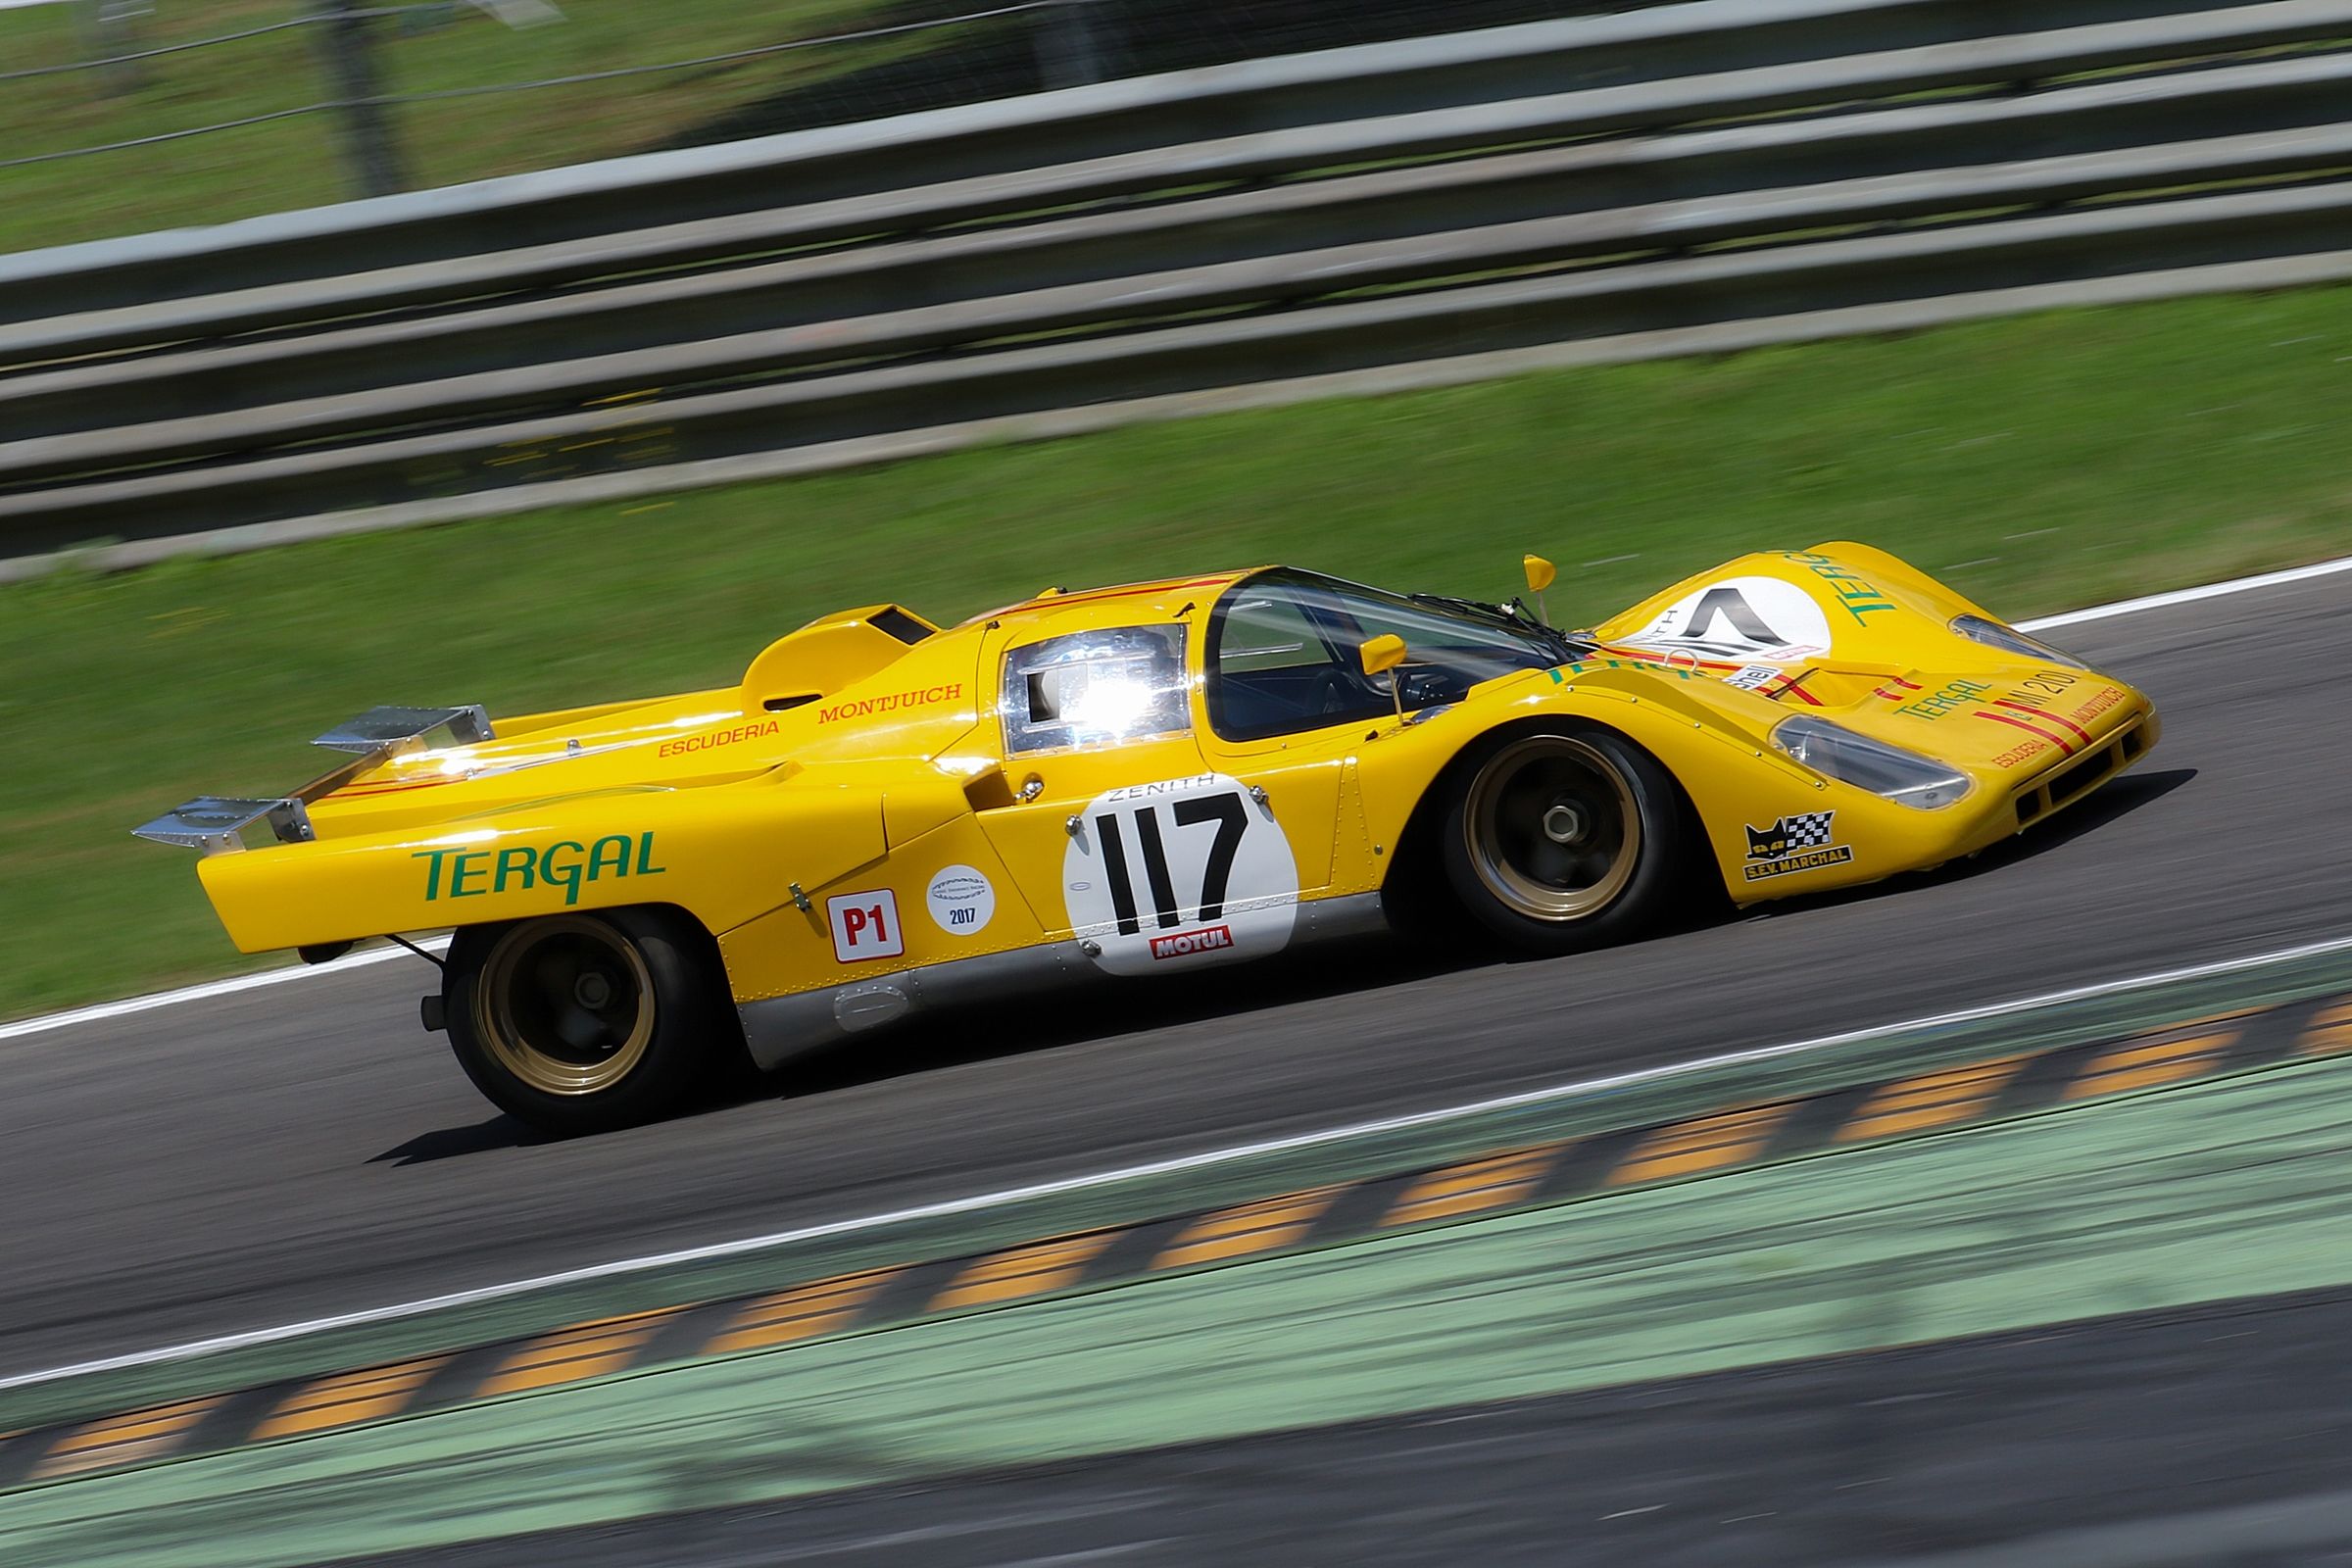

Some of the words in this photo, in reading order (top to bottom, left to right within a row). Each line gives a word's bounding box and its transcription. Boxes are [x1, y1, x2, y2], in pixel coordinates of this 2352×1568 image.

[1892, 678, 1993, 721] TERGAL
[658, 720, 780, 759] ESCUDERIA
[817, 683, 963, 725] MONTJUICH
[1991, 739, 2048, 768] ESCUDERIA
[1107, 774, 1216, 803] ZENITH
[411, 830, 666, 906] TERGAL
[1095, 791, 1250, 937] 117
[1779, 849, 1848, 873] MARCHAL
[843, 904, 887, 947] P1
[949, 906, 976, 925] 2017
[1156, 929, 1229, 957] MOTUL
